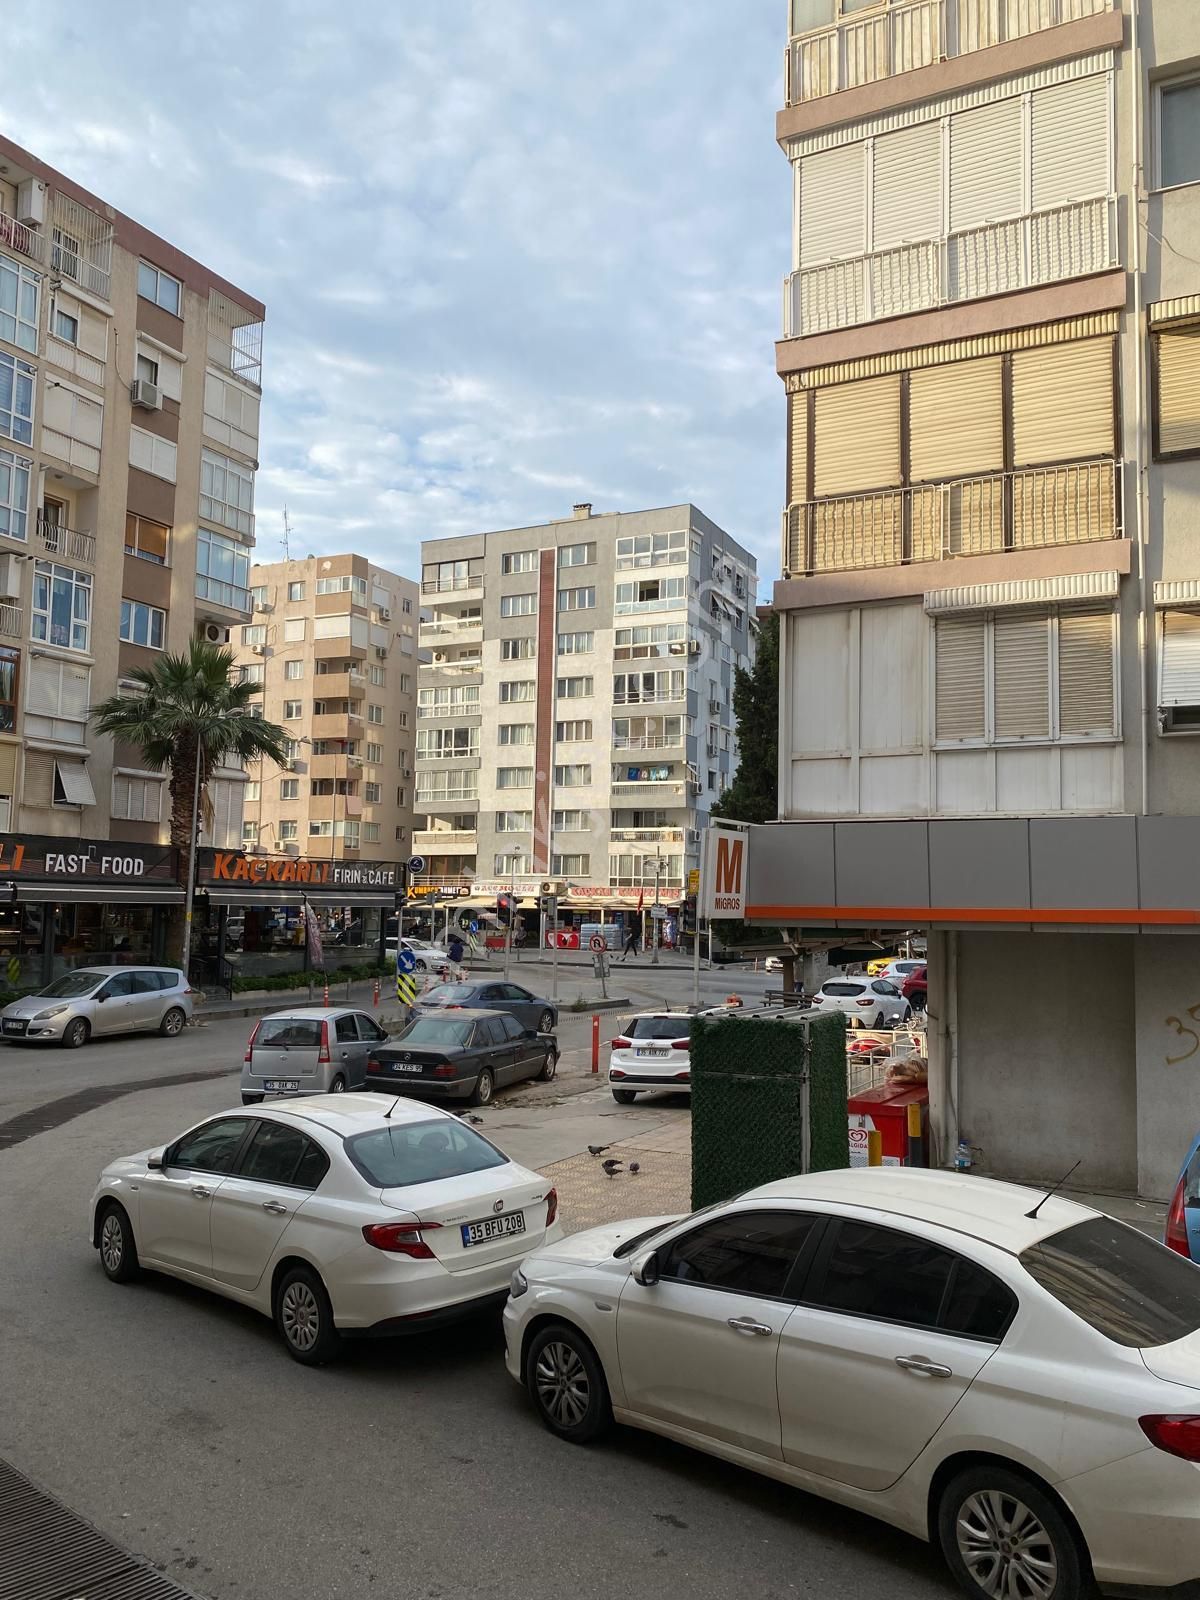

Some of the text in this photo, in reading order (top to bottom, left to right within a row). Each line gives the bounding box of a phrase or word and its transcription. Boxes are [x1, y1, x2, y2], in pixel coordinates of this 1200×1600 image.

[45, 853, 144, 876] FAST FOOD
[212, 852, 331, 886] KAÇKARLI
[334, 868, 361, 884] FIRIN
[368, 870, 395, 885] CAFE
[716, 837, 743, 894] M
[470, 1224, 483, 1240] 35
[484, 1219, 503, 1236] BFU
[505, 1214, 522, 1231] 208
